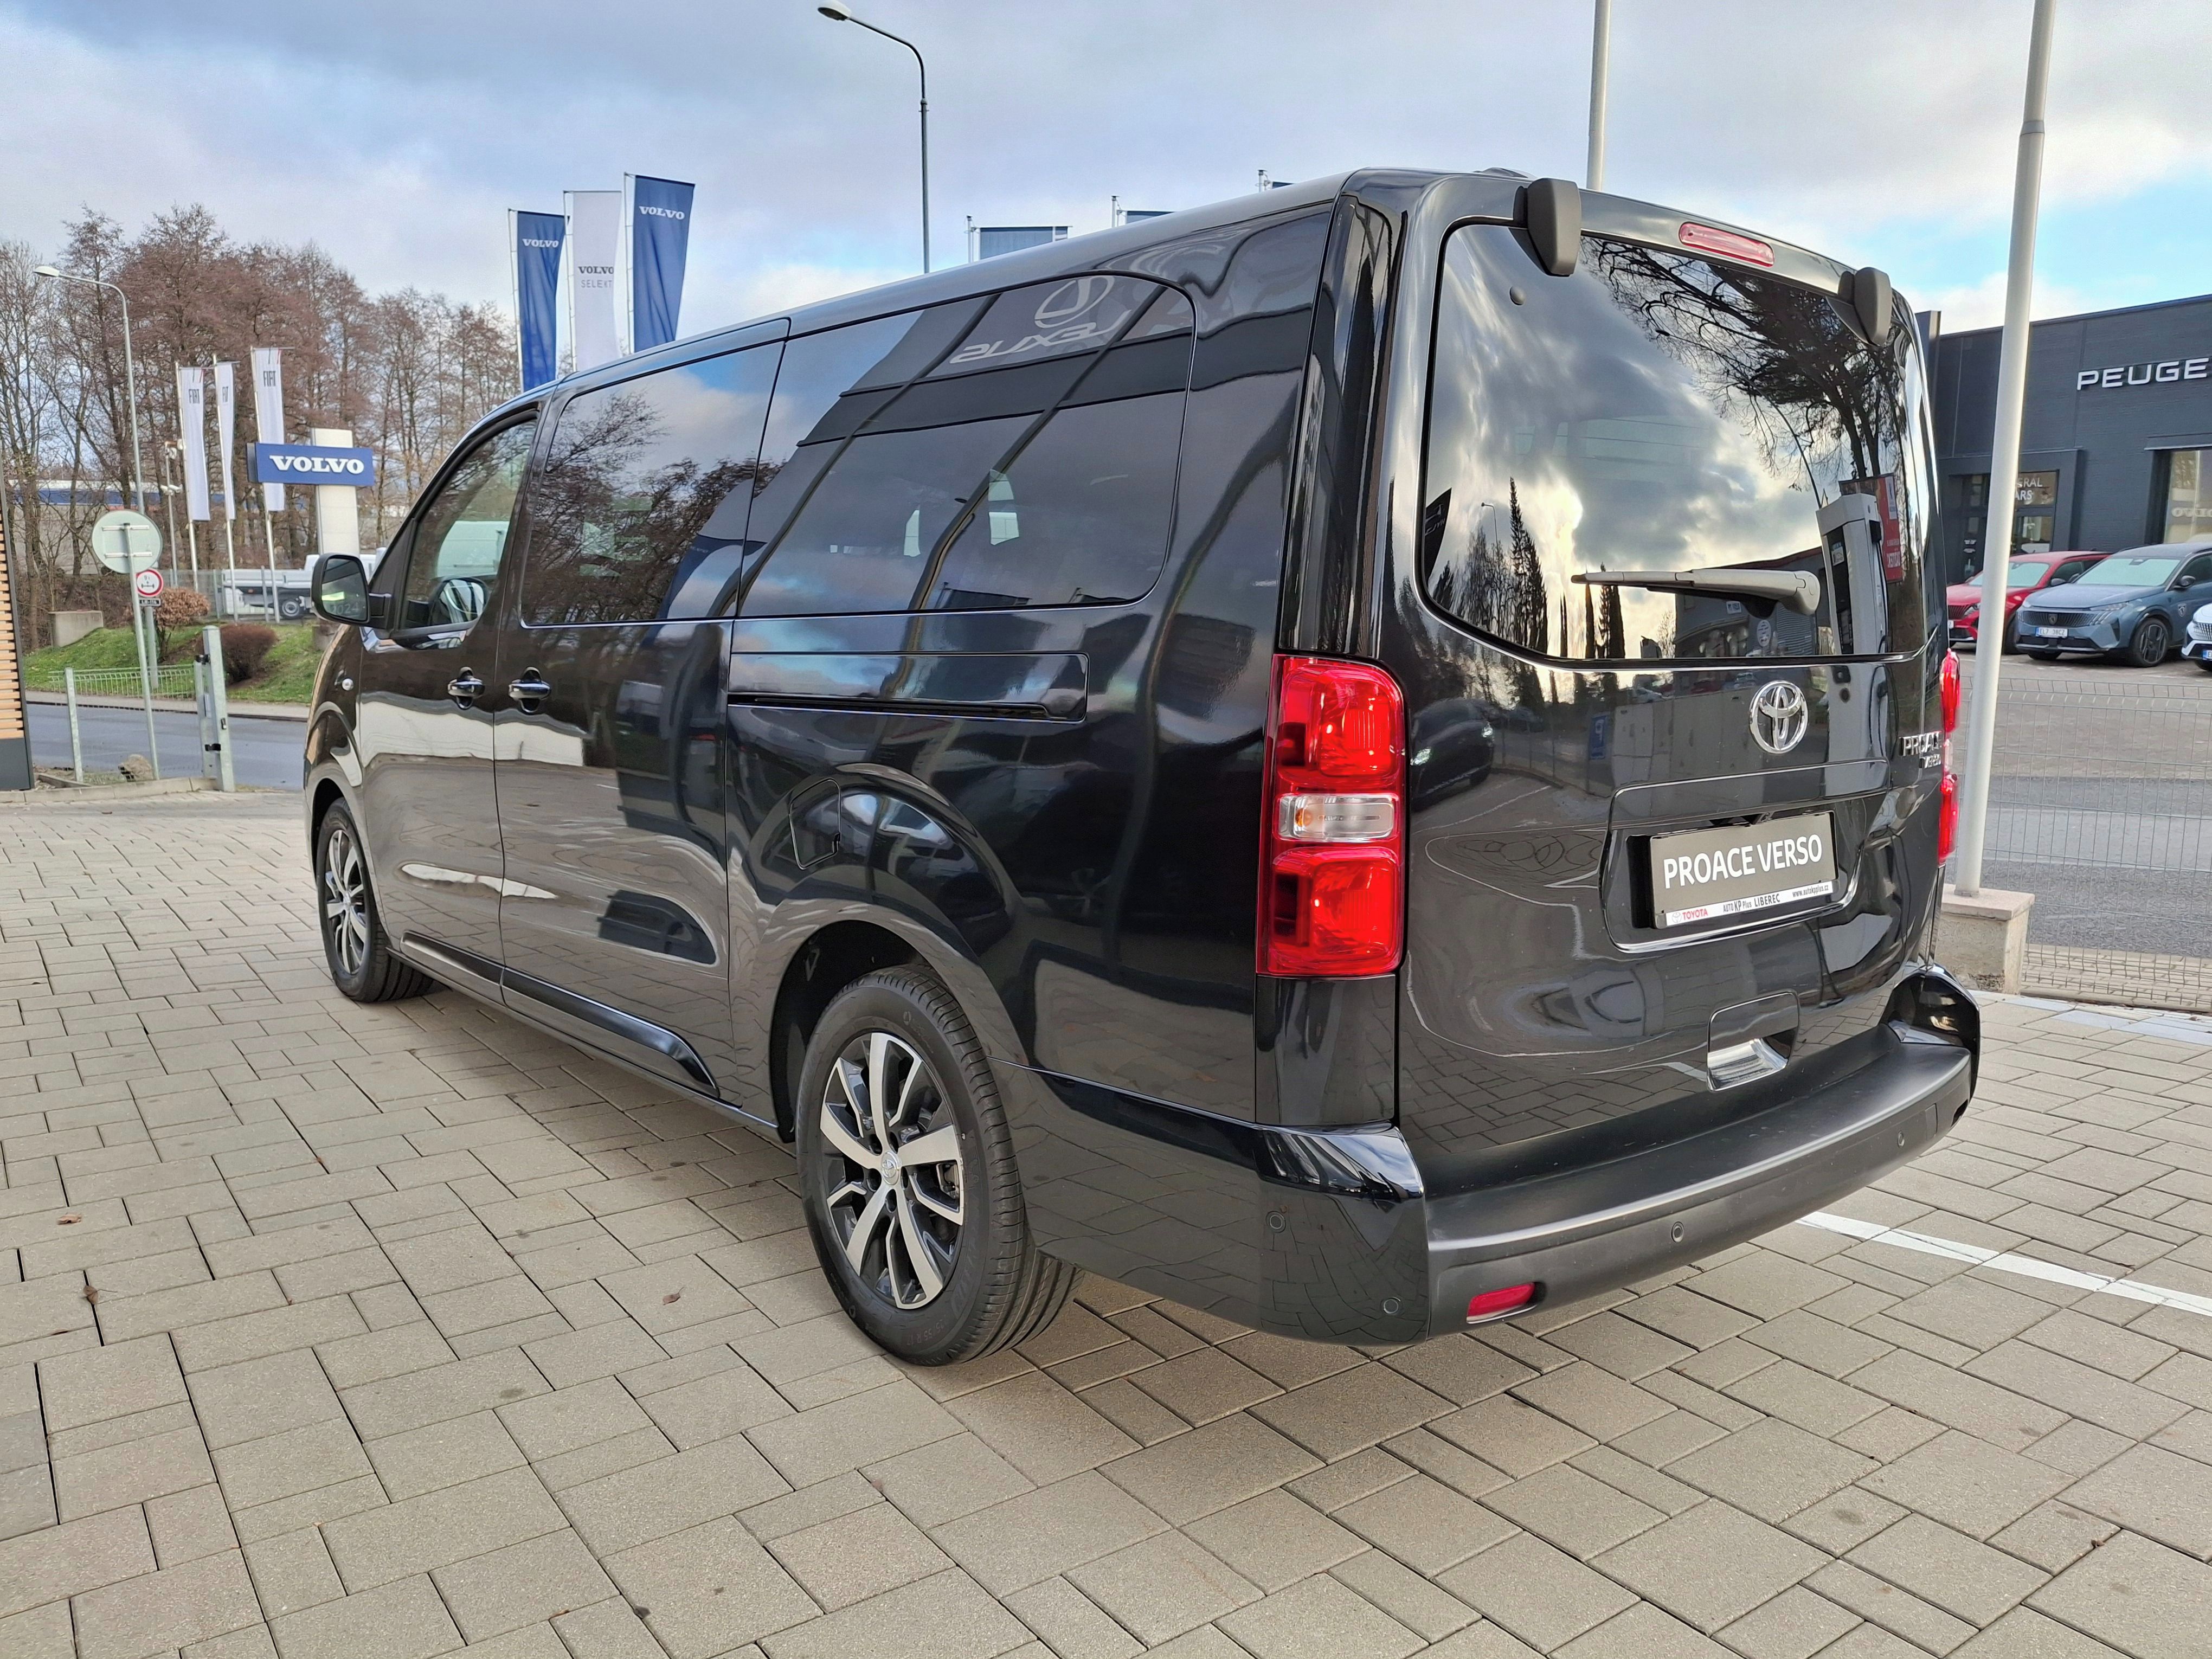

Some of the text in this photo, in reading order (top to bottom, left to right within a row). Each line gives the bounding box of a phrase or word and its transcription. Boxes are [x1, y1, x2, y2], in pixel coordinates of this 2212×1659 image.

[639, 205, 685, 220] VOLVO
[522, 239, 559, 248] VOLVO
[577, 266, 614, 274] VOLVO
[263, 370, 276, 387] FIAT
[2076, 357, 2209, 391] PEUGE
[189, 389, 200, 403] FIAT
[269, 455, 365, 474] VOLVO
[2015, 490, 2033, 500] ARS
[1663, 834, 1822, 889] PROACE VERSO
[1682, 884, 1829, 921] TOYOTA AUTO KP Plus LIBEREC www.autokpplus.cz
